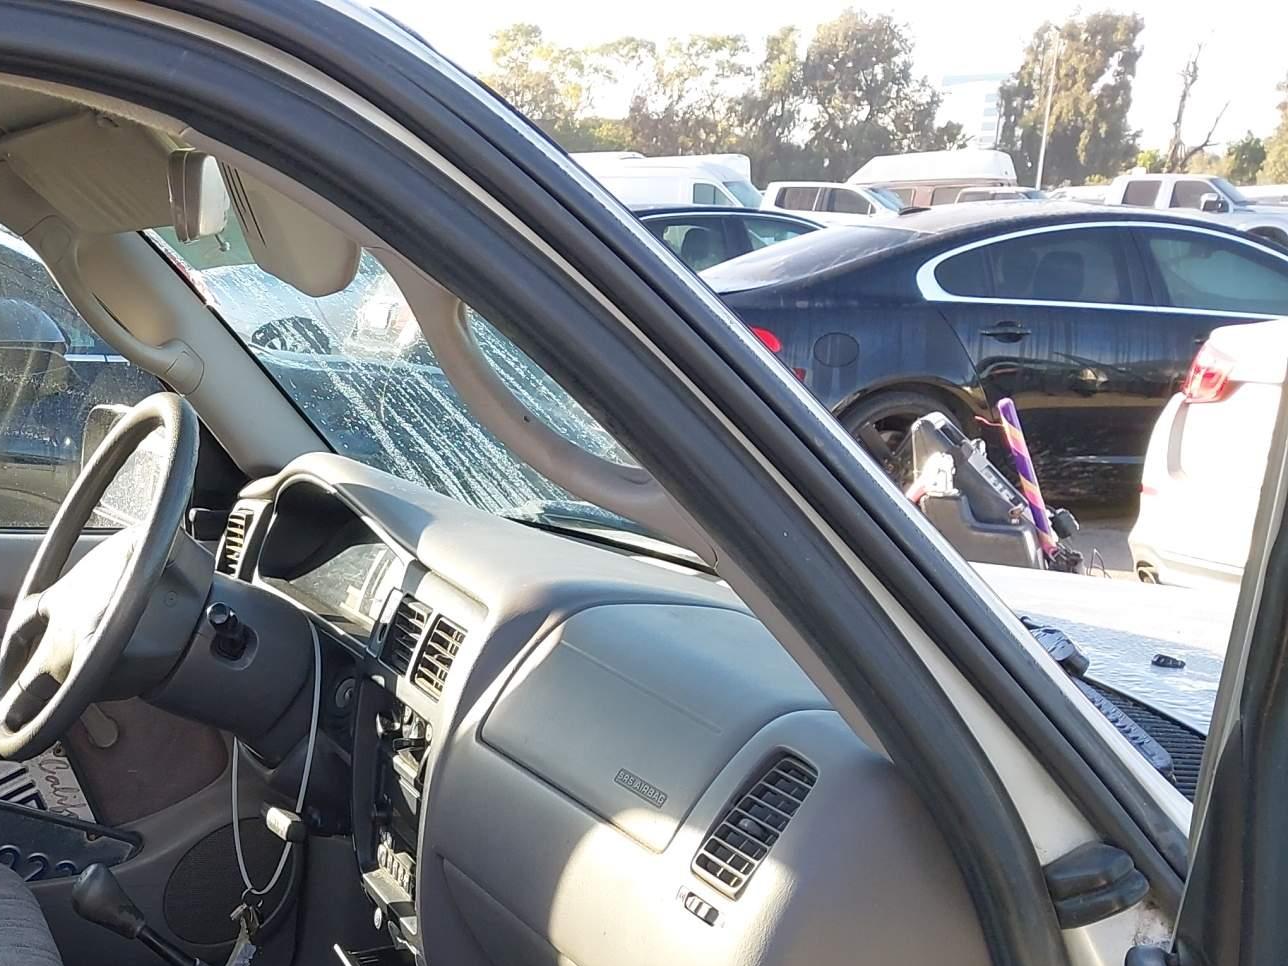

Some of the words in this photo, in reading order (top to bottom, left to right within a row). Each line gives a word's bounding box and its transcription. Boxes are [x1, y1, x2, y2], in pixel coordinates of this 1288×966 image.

[39, 759, 87, 819] Calif
[617, 771, 634, 786] SRS
[634, 782, 666, 805] AIRBAG
